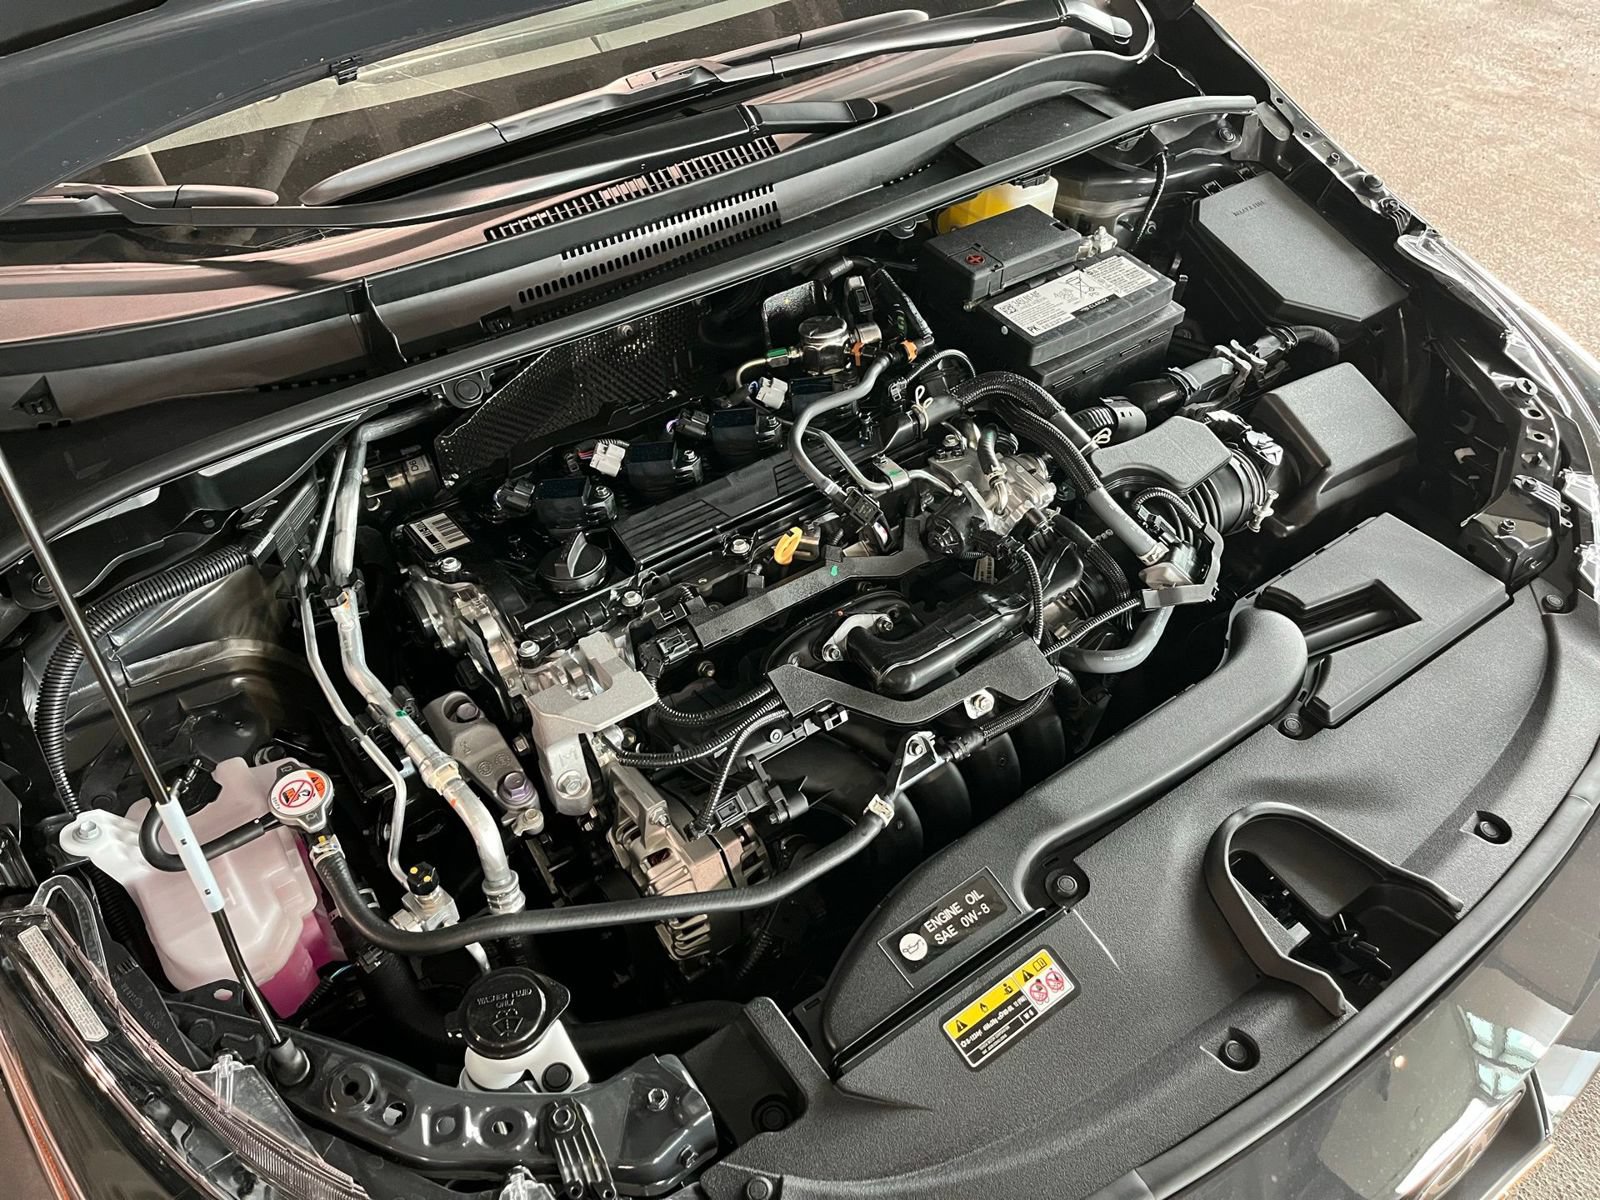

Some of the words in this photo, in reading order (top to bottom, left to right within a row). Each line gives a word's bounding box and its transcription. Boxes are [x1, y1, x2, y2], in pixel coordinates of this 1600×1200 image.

[924, 902, 963, 932] ENGINE
[964, 890, 984, 905] OIL
[934, 925, 958, 944] SAE
[960, 903, 990, 927] 0W-8
[511, 989, 532, 998] FLUID
